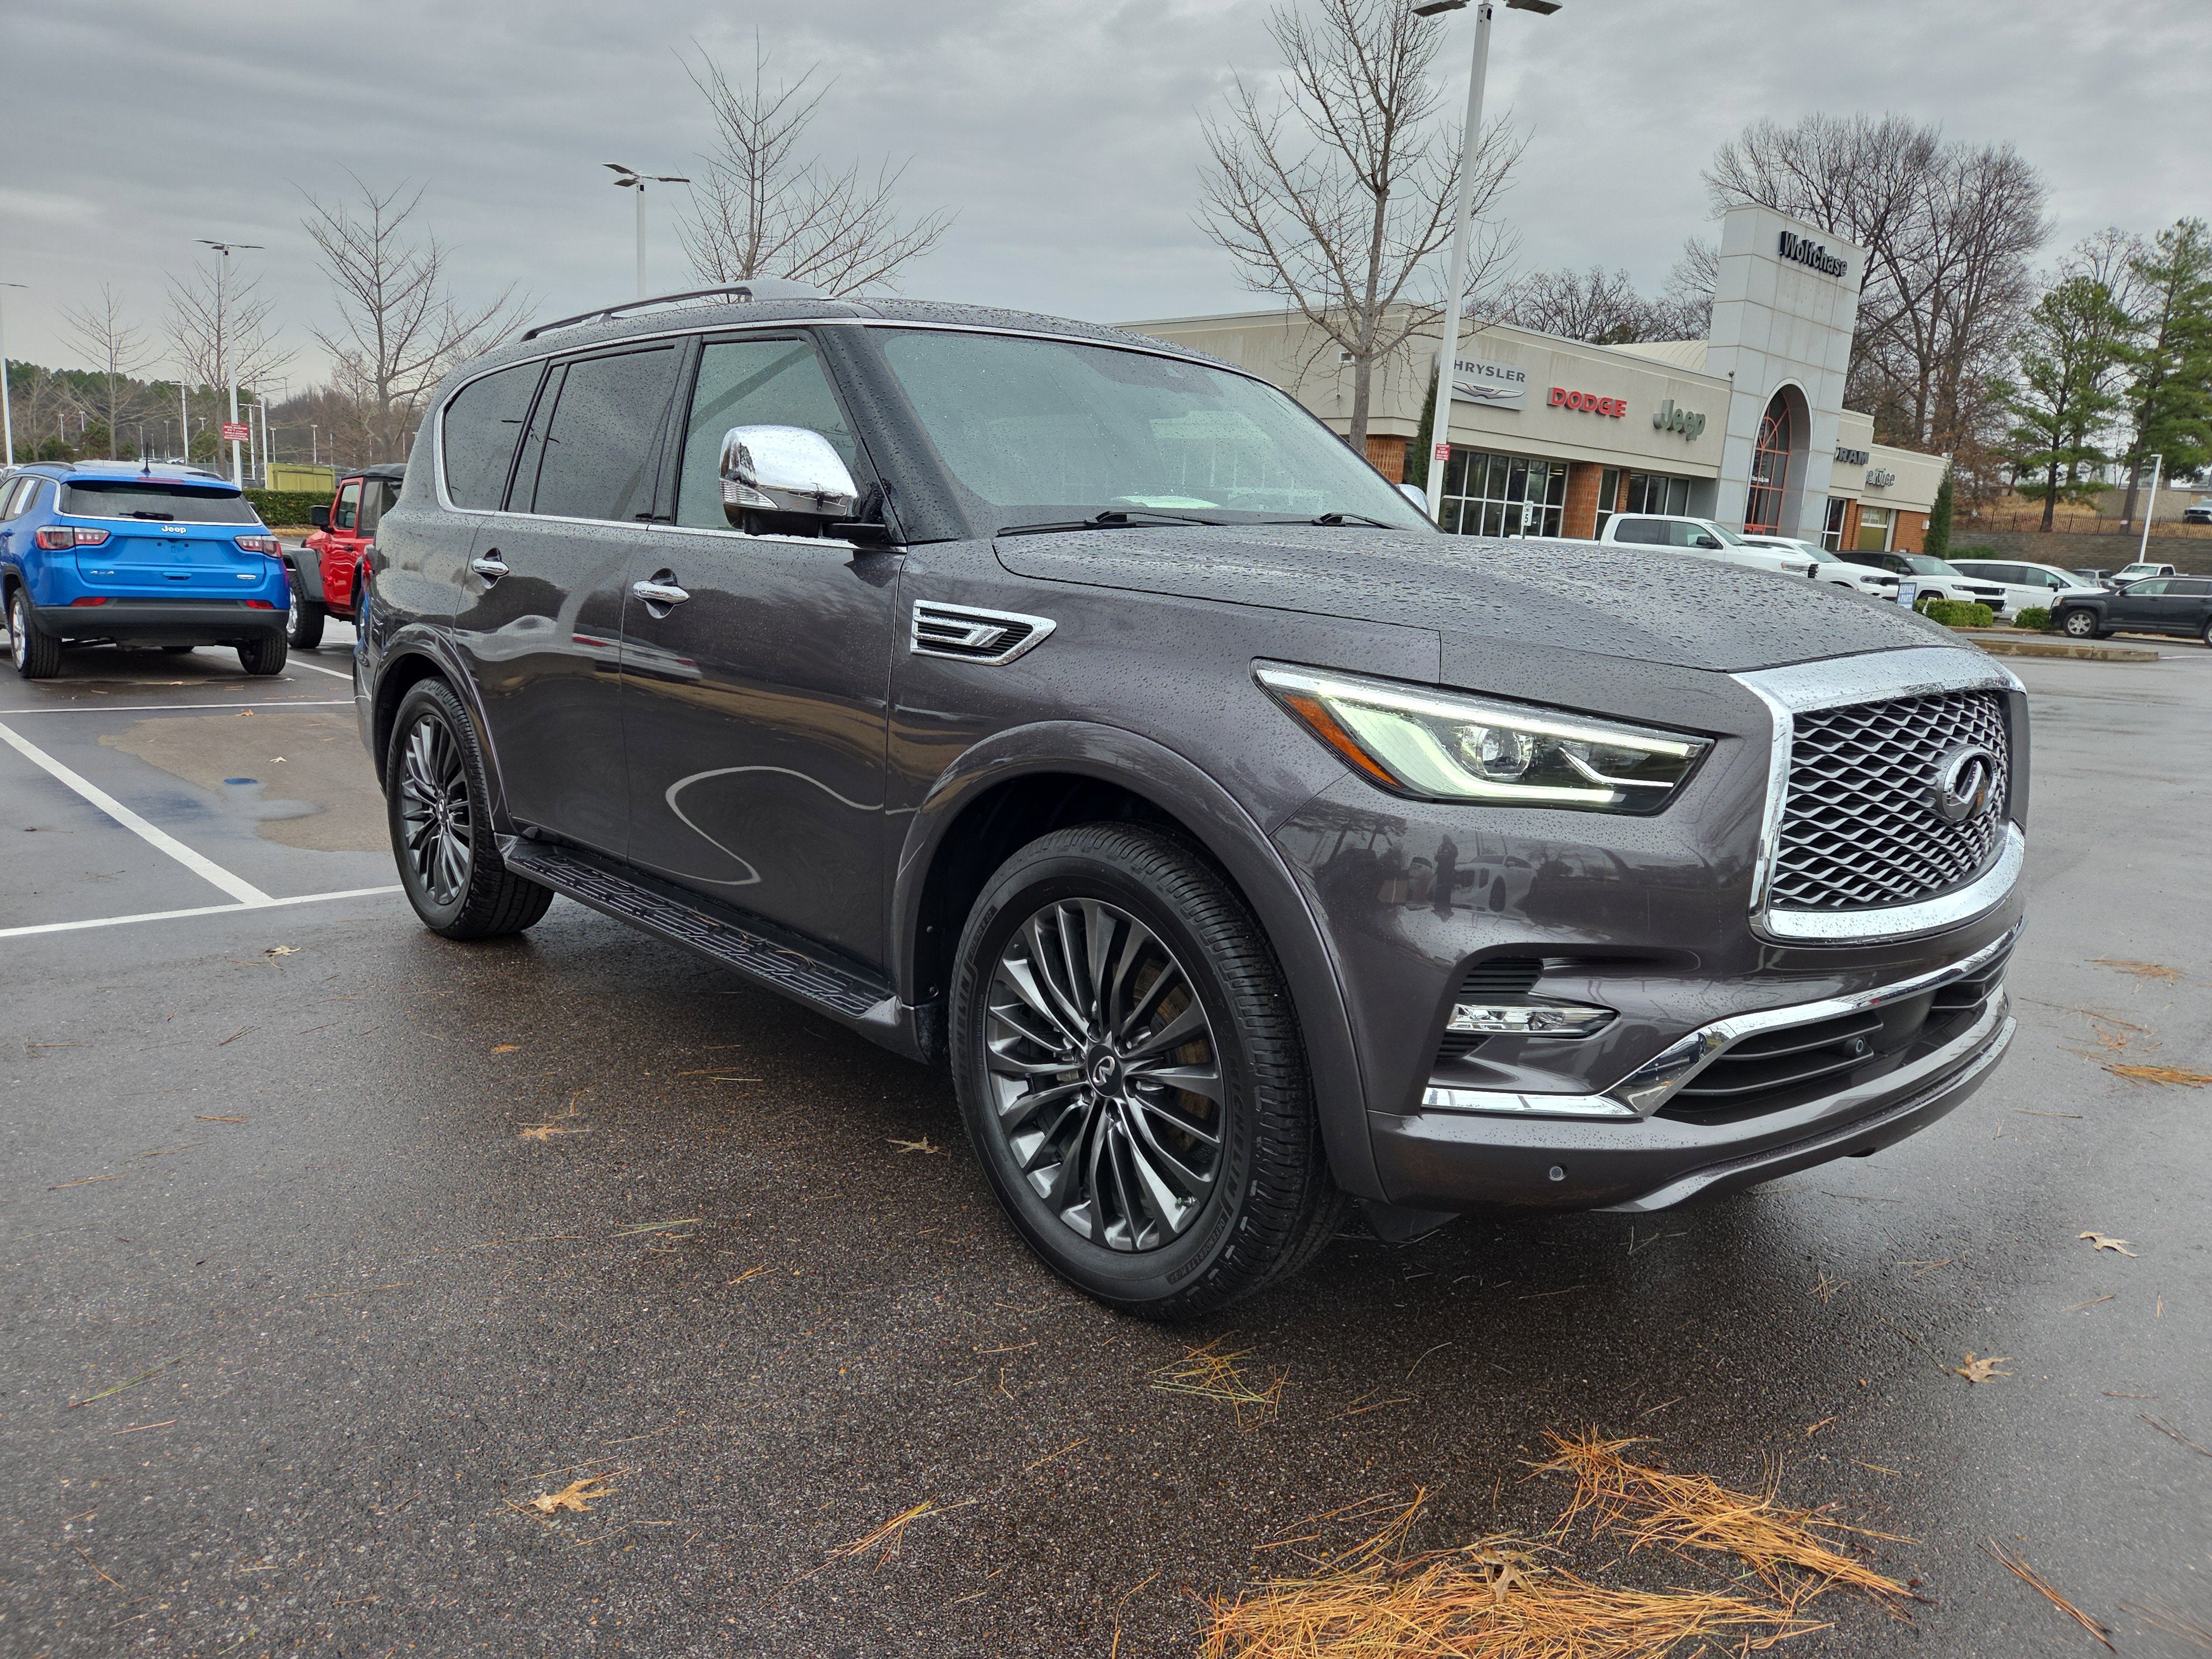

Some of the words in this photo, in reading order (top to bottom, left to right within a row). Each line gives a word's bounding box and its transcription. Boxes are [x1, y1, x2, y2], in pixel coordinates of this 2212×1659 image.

[1780, 231, 1848, 276] Wolfchase
[1454, 359, 1526, 382] HRYSLER
[1547, 387, 1627, 417] DODGE
[1654, 400, 1706, 441] Jeep
[1838, 447, 1869, 465] RAM
[1866, 468, 1895, 487] ervice
[161, 525, 187, 534] Jeep
[1525, 513, 1529, 523] 5
[1198, 1218, 1225, 1259] DEFENDER
